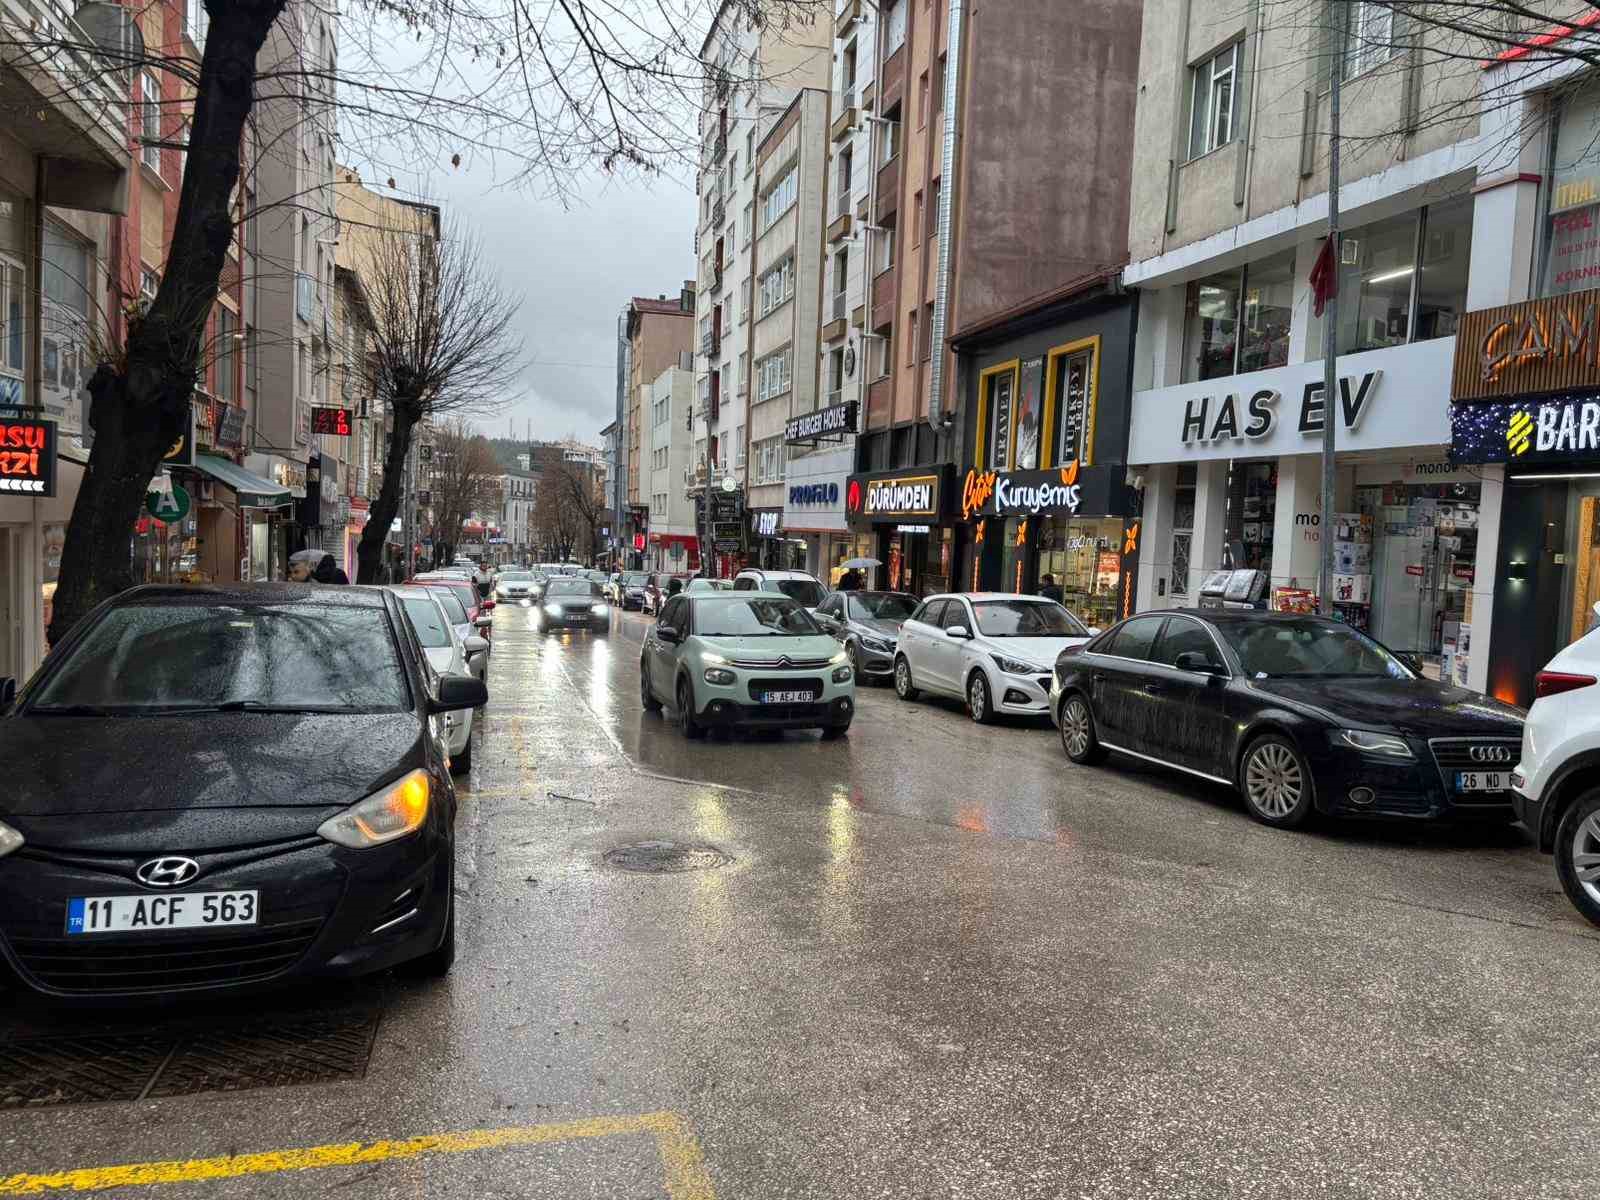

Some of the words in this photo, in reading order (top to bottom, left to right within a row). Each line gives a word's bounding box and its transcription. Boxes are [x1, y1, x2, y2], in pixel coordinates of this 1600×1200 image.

[784, 420, 798, 440] CHEF
[798, 413, 822, 437] BURGER
[823, 406, 846, 431] HOUSE
[1066, 371, 1080, 457] TURKEY
[1182, 388, 1281, 447] HAS
[1298, 369, 1383, 437] EV
[869, 481, 931, 510] DÜRÜMDEN
[1463, 774, 1477, 788] 26
[89, 900, 112, 928] 11
[132, 896, 185, 926] ACF
[202, 893, 255, 923] 563
